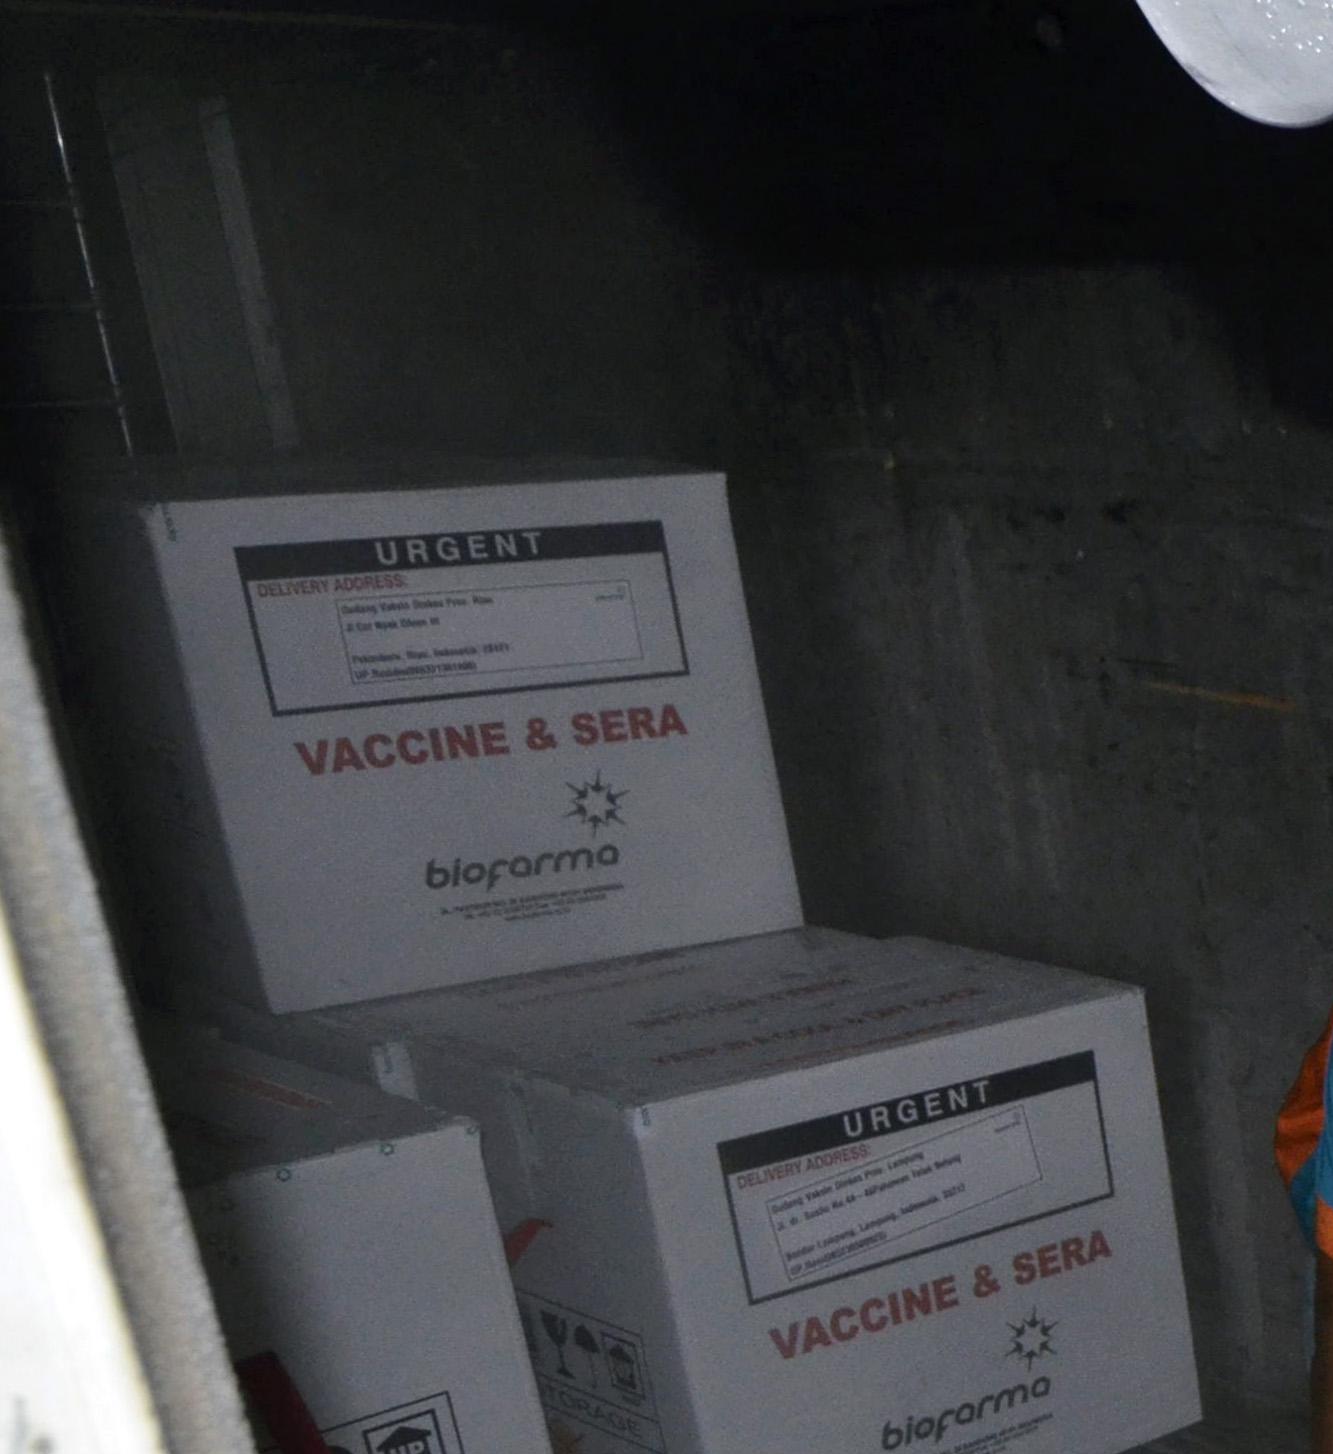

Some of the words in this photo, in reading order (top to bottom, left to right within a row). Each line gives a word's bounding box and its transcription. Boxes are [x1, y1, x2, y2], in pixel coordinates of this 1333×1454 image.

[376, 532, 541, 566] URGENT
[257, 579, 330, 598] DELIVERY
[334, 573, 408, 592] ADDRESS:
[293, 721, 511, 776] VACCINE
[525, 717, 560, 752] &
[571, 703, 689, 747] SERA
[423, 842, 621, 892] biofarma
[841, 1080, 991, 1138] URGENT
[736, 1158, 811, 1191] DELIVERY
[804, 1143, 872, 1173] ADDRESS:
[768, 1274, 960, 1360] VACCINE
[972, 1264, 1001, 1299] &
[1012, 1229, 1113, 1286] SERA
[881, 1375, 1052, 1451] biofarma
